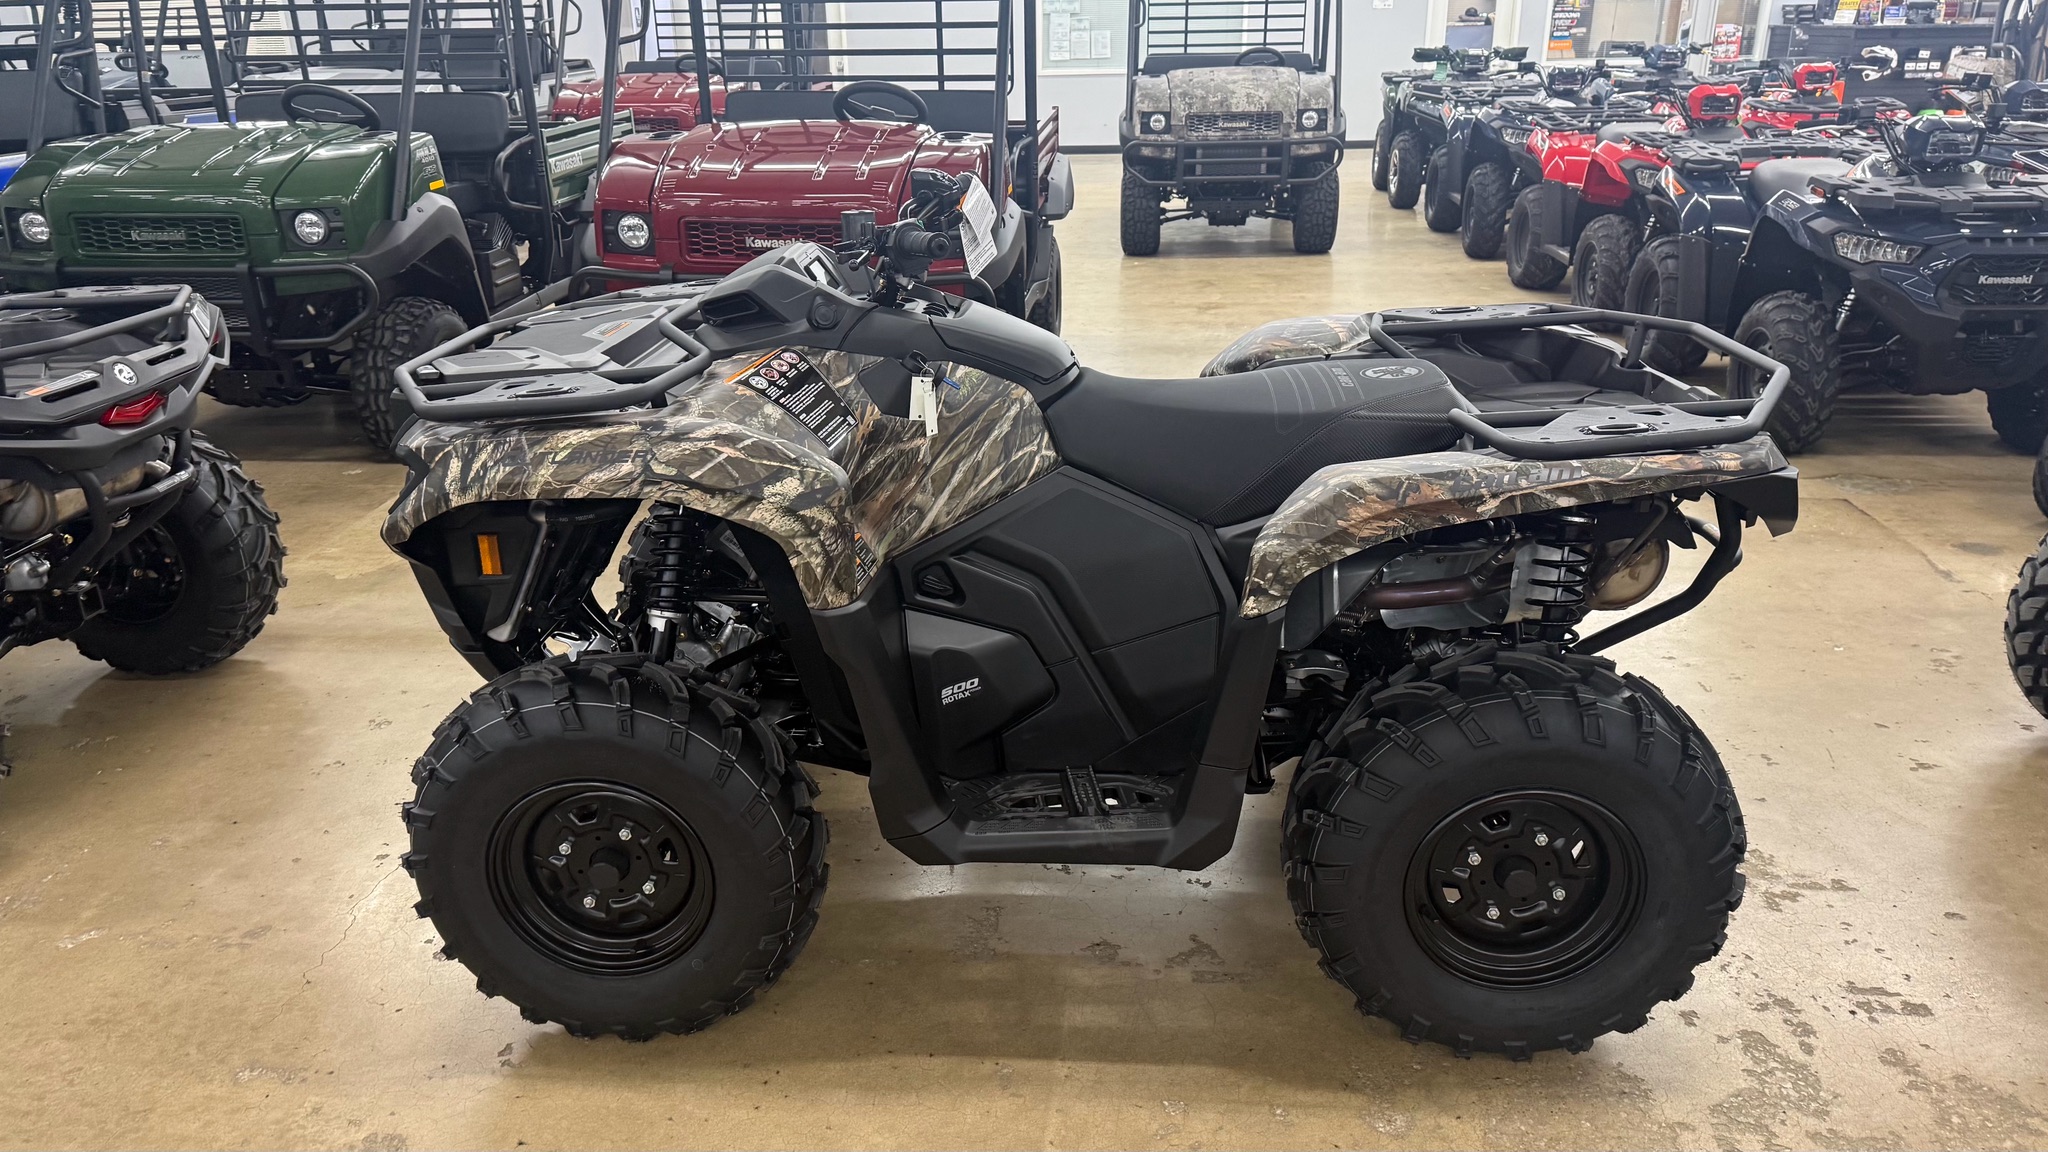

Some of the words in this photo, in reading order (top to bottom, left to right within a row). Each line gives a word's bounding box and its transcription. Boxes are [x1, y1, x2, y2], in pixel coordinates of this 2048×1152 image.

[549, 151, 583, 174] Kawasaki
[130, 230, 186, 240] Kawasaki
[1978, 274, 2034, 285] Kawasaki
[941, 678, 979, 698] 500
[942, 690, 971, 705] ROTAX
